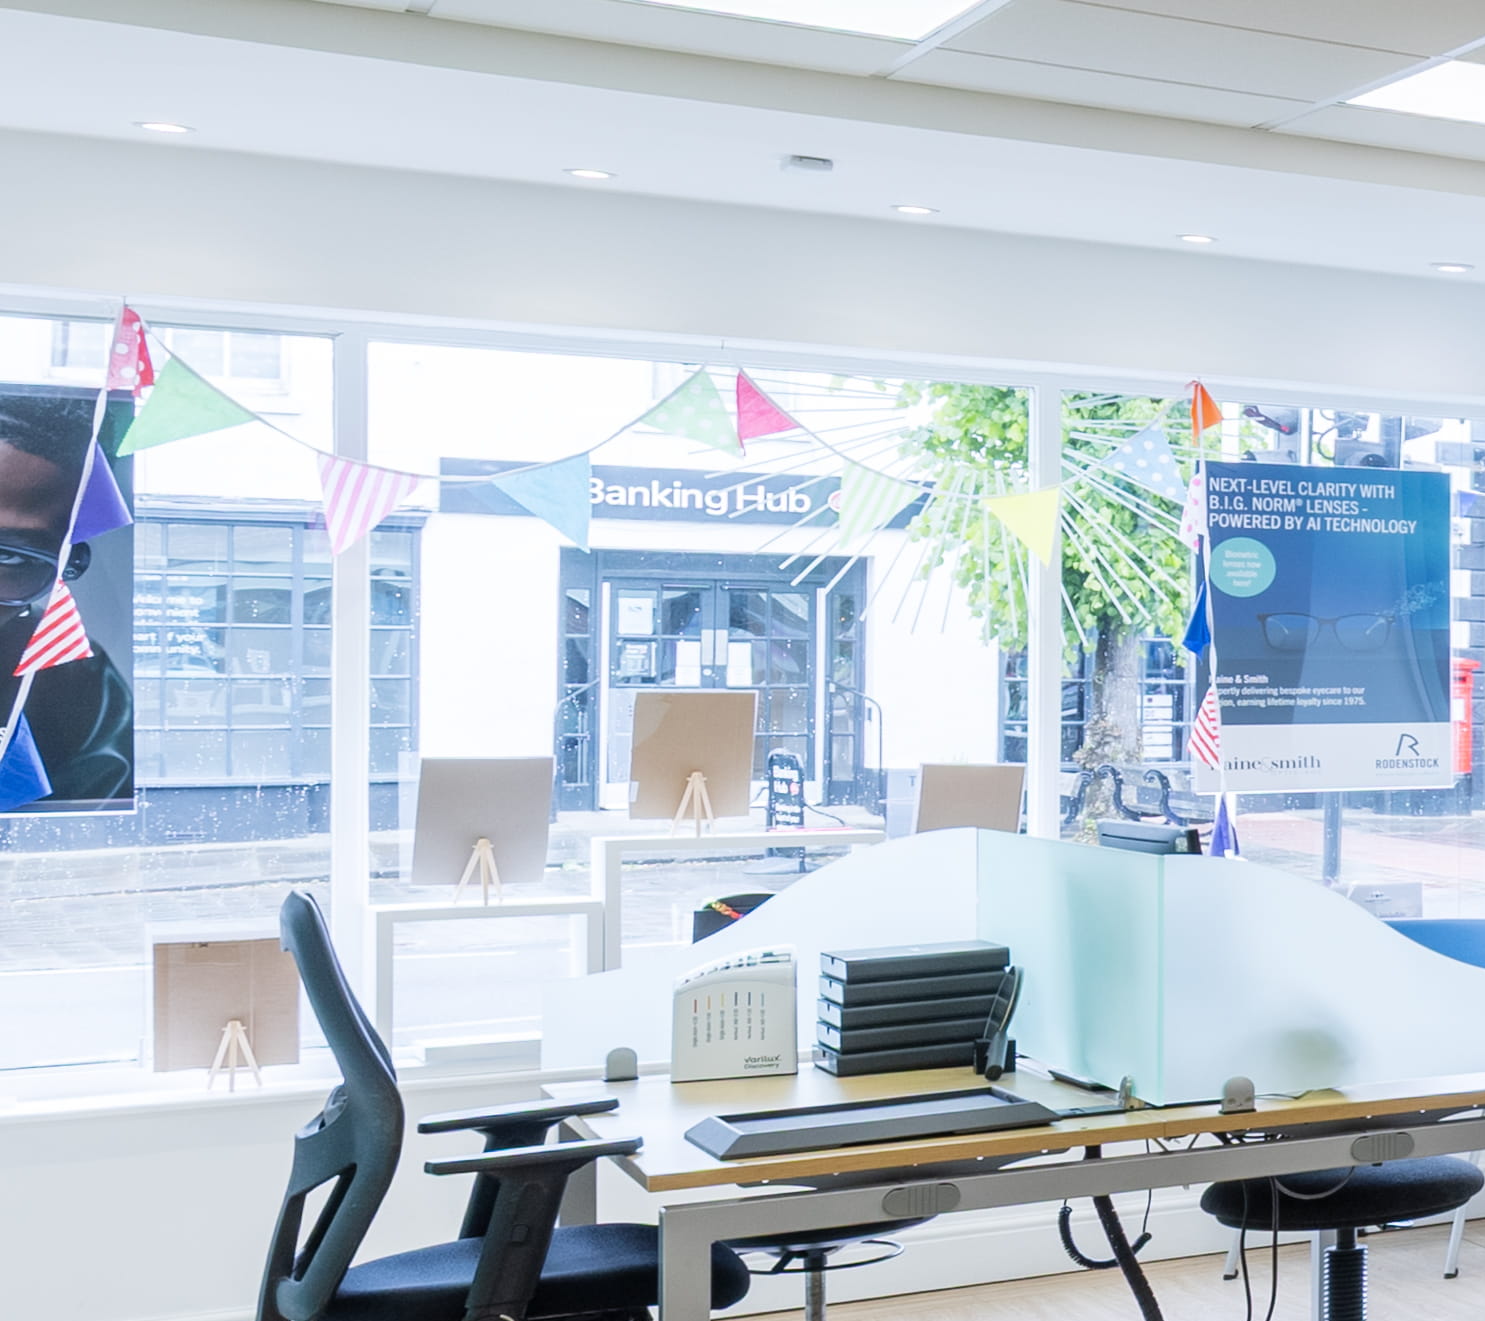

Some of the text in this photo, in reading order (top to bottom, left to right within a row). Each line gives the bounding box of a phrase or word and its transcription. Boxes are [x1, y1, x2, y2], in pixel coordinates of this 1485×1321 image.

[588, 478, 812, 516] Banking Hub
[1209, 477, 1395, 499] NEXT-LEVEL CLARITY WITH
[1209, 495, 1248, 511] B.I.G.
[1306, 500, 1359, 514] LENSES
[1209, 512, 1417, 534] POWERED BY AI TECHNOLOGY
[1241, 686, 1278, 697] delivering
[1312, 688, 1342, 696] eyecare
[1323, 698, 1343, 706] since
[1375, 758, 1439, 769] RODENSTOCK
